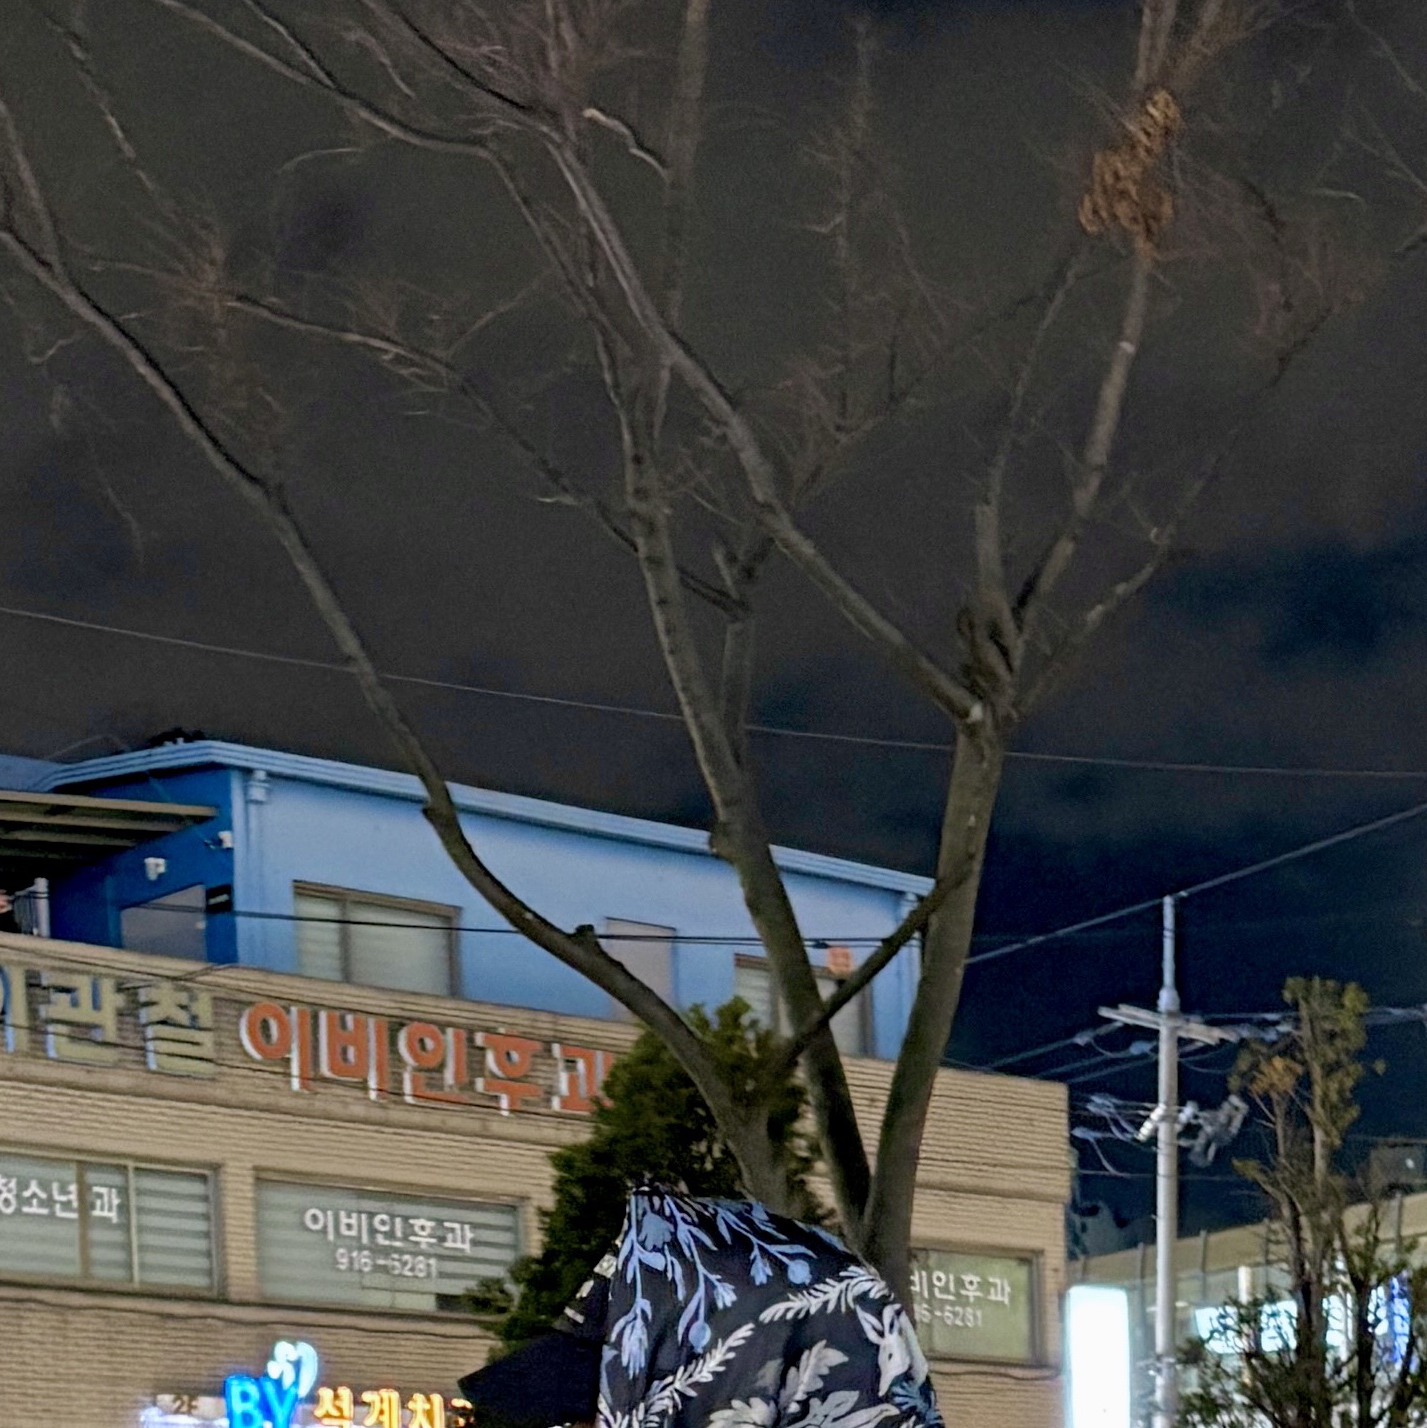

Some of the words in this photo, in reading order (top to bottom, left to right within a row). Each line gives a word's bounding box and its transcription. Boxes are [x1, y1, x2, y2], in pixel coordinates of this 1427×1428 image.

[239, 1002, 616, 1117] 이비인후과
[304, 1207, 474, 1253] 이비인후과
[910, 1269, 1011, 1307] 비인후과
